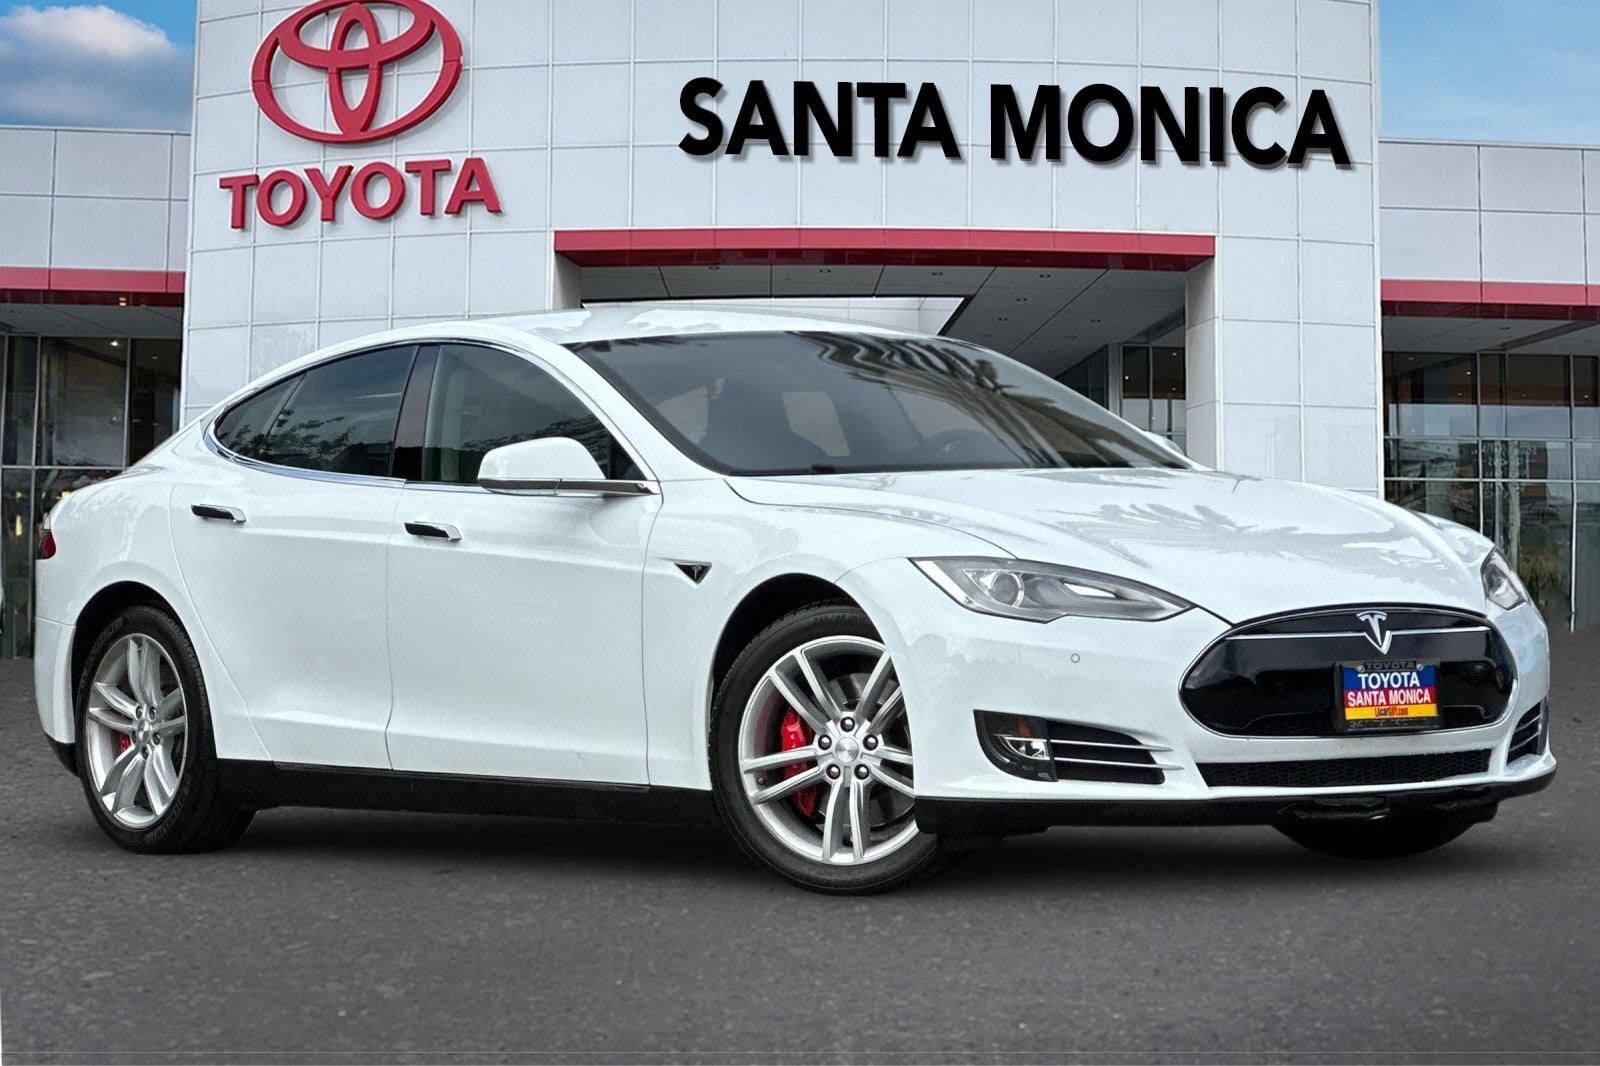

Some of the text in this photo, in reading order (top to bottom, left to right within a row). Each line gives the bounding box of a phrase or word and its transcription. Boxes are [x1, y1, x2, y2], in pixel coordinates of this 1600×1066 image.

[679, 78, 1352, 168] SANTA MONICA
[219, 157, 502, 229] TOYOTA
[1366, 661, 1415, 670] TOYOTA
[1357, 671, 1421, 690] TOYOTA
[1347, 688, 1431, 707] SANTA MONICA
